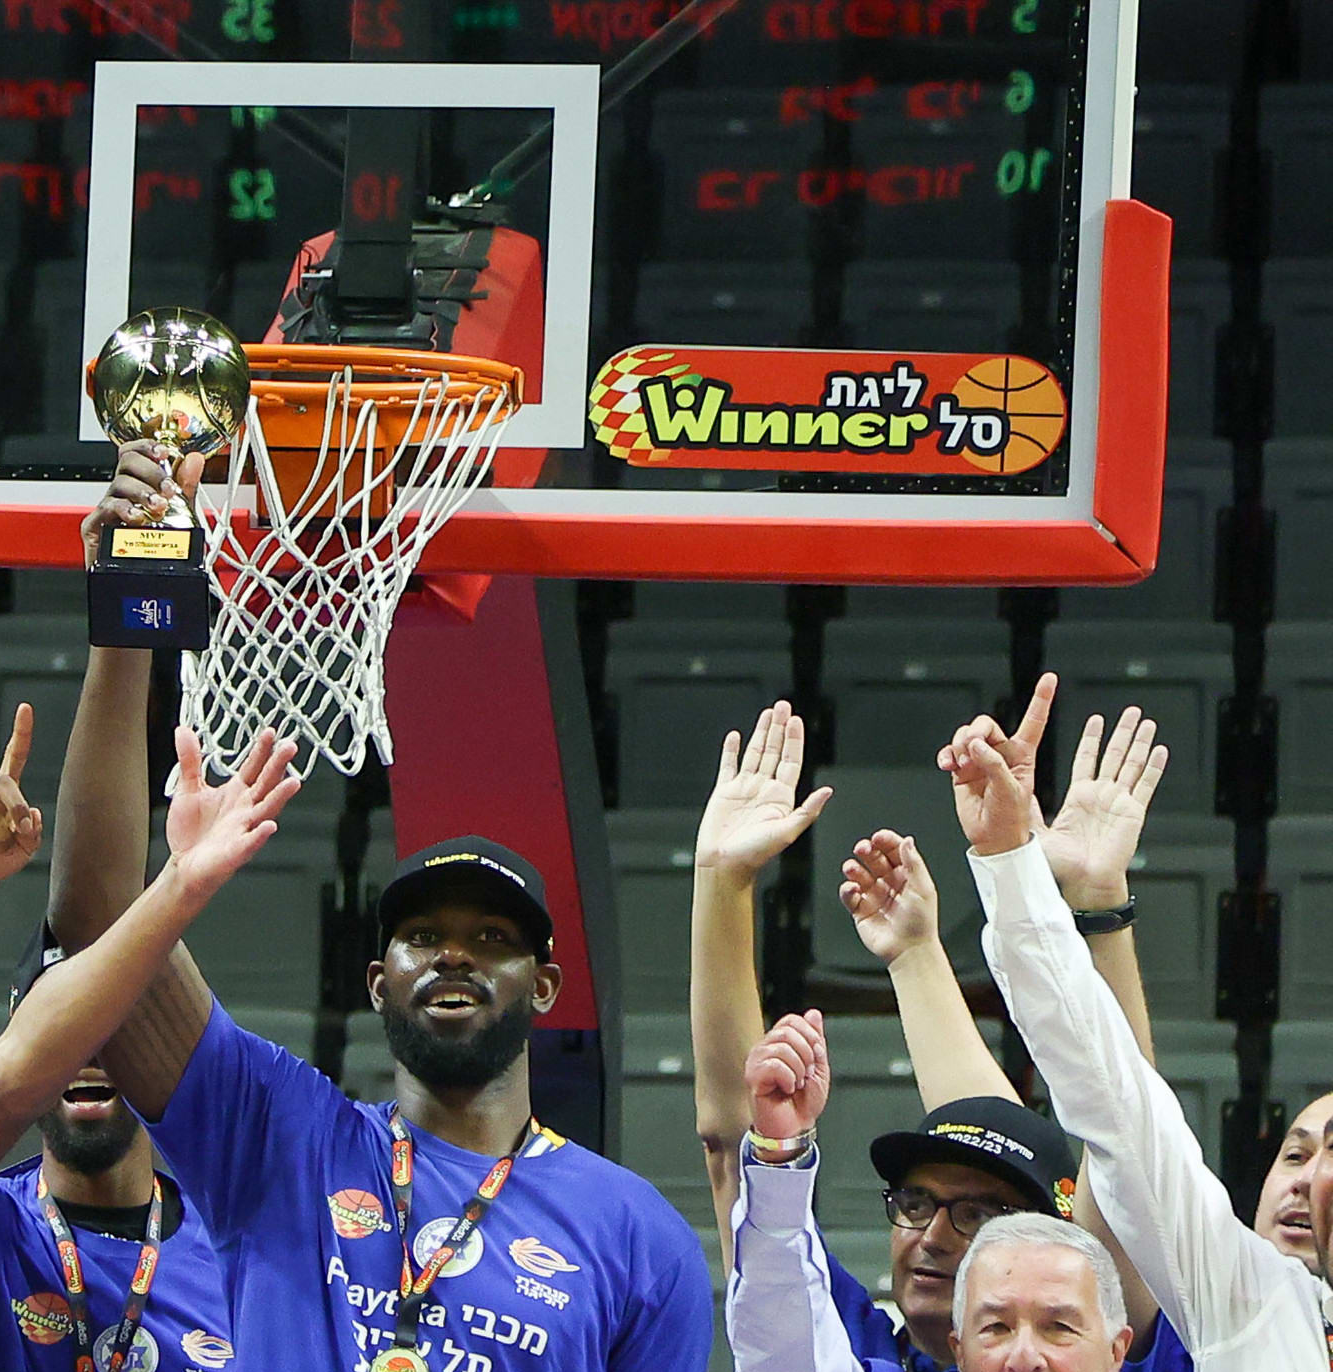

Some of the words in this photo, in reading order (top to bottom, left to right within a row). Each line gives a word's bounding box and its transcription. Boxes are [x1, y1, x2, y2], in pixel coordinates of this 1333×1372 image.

[825, 365, 926, 411] ליגת
[643, 380, 931, 451] Winner
[938, 397, 1008, 454] סל
[139, 532, 165, 540] MVP
[10, 1298, 66, 1333] Winner
[461, 1305, 549, 1357] מכבי
